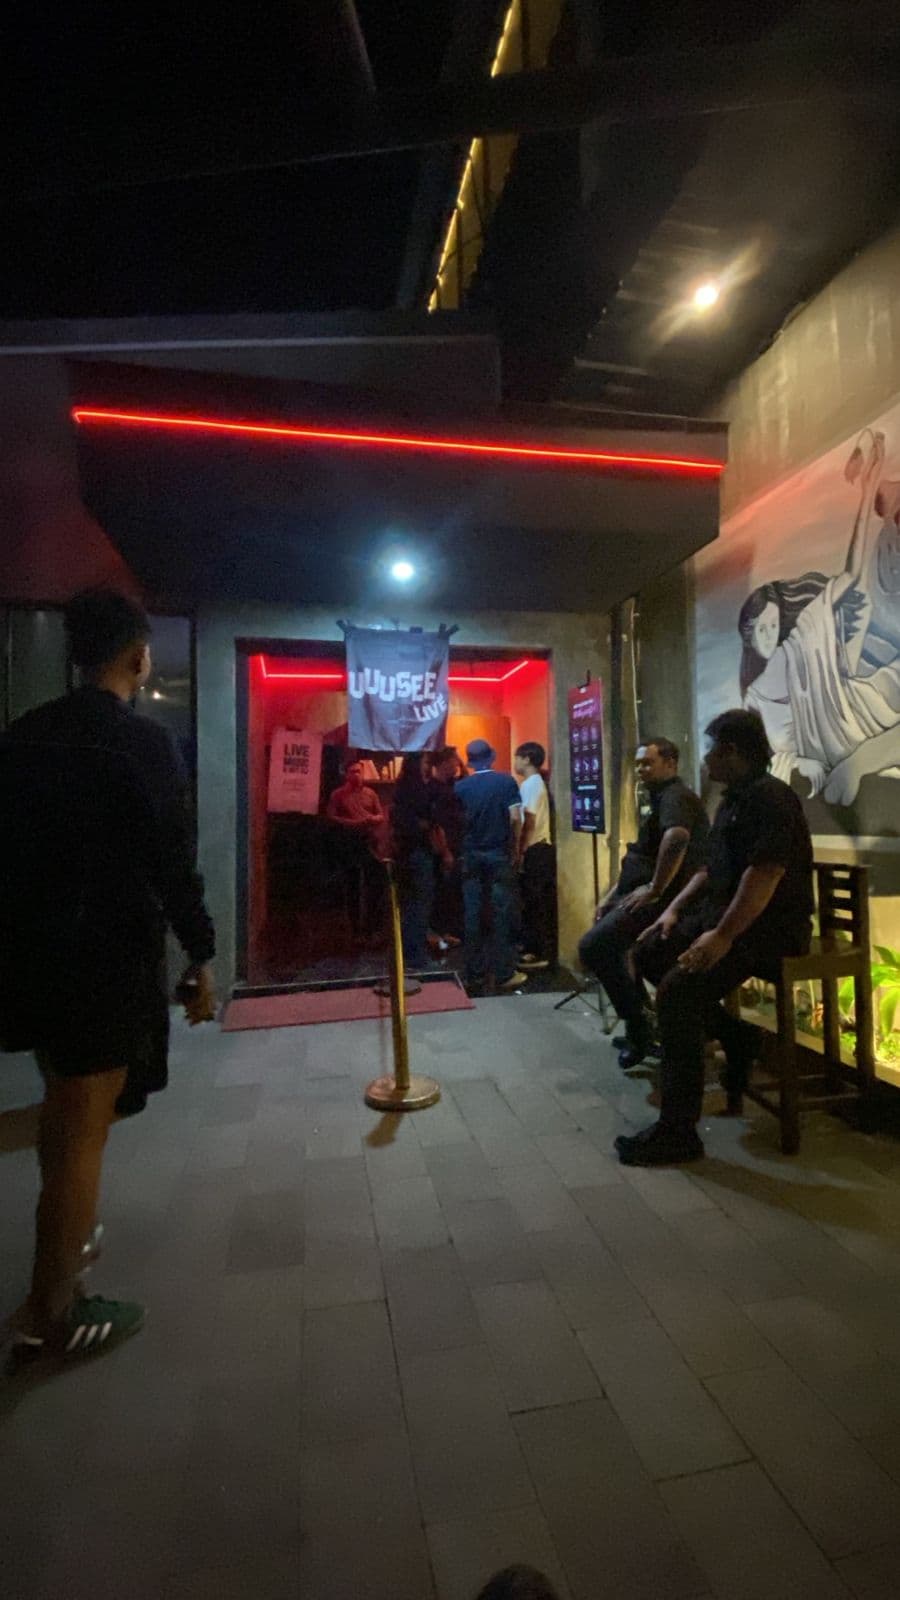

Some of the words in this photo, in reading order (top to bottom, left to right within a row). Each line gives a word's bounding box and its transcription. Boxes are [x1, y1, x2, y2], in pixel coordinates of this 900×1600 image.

[348, 667, 437, 701] UUUSEE
[413, 693, 447, 721] LIVE
[284, 743, 310, 757] LIVE
